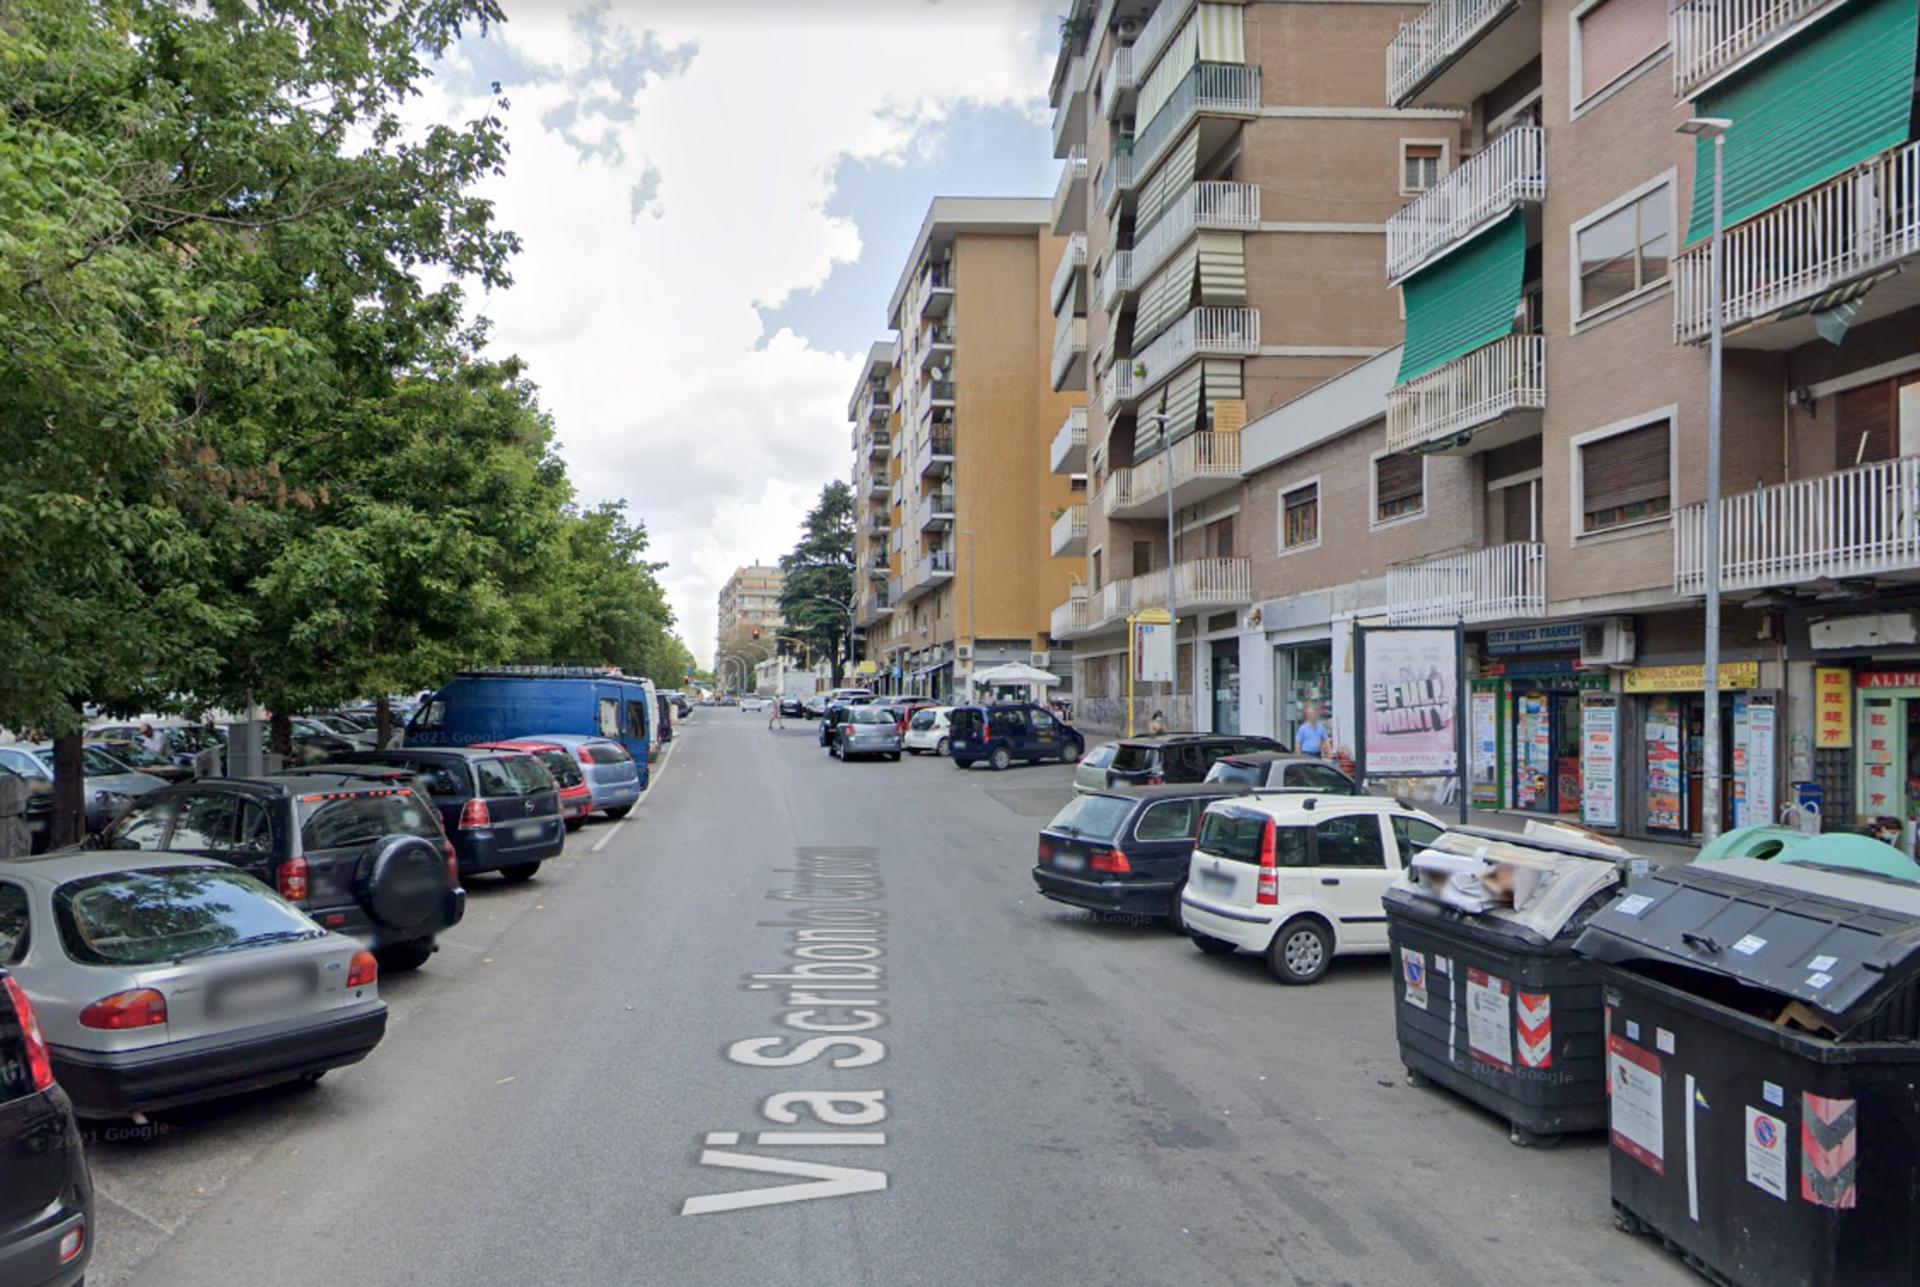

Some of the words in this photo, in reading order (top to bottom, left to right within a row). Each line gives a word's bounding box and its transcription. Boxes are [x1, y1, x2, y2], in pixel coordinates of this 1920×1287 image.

[1489, 631, 1506, 643] CITY
[1508, 628, 1536, 641] MONEY
[1869, 673, 1920, 687] ALIM
[1387, 679, 1448, 708] FULL
[1376, 705, 1450, 735] MONTY
